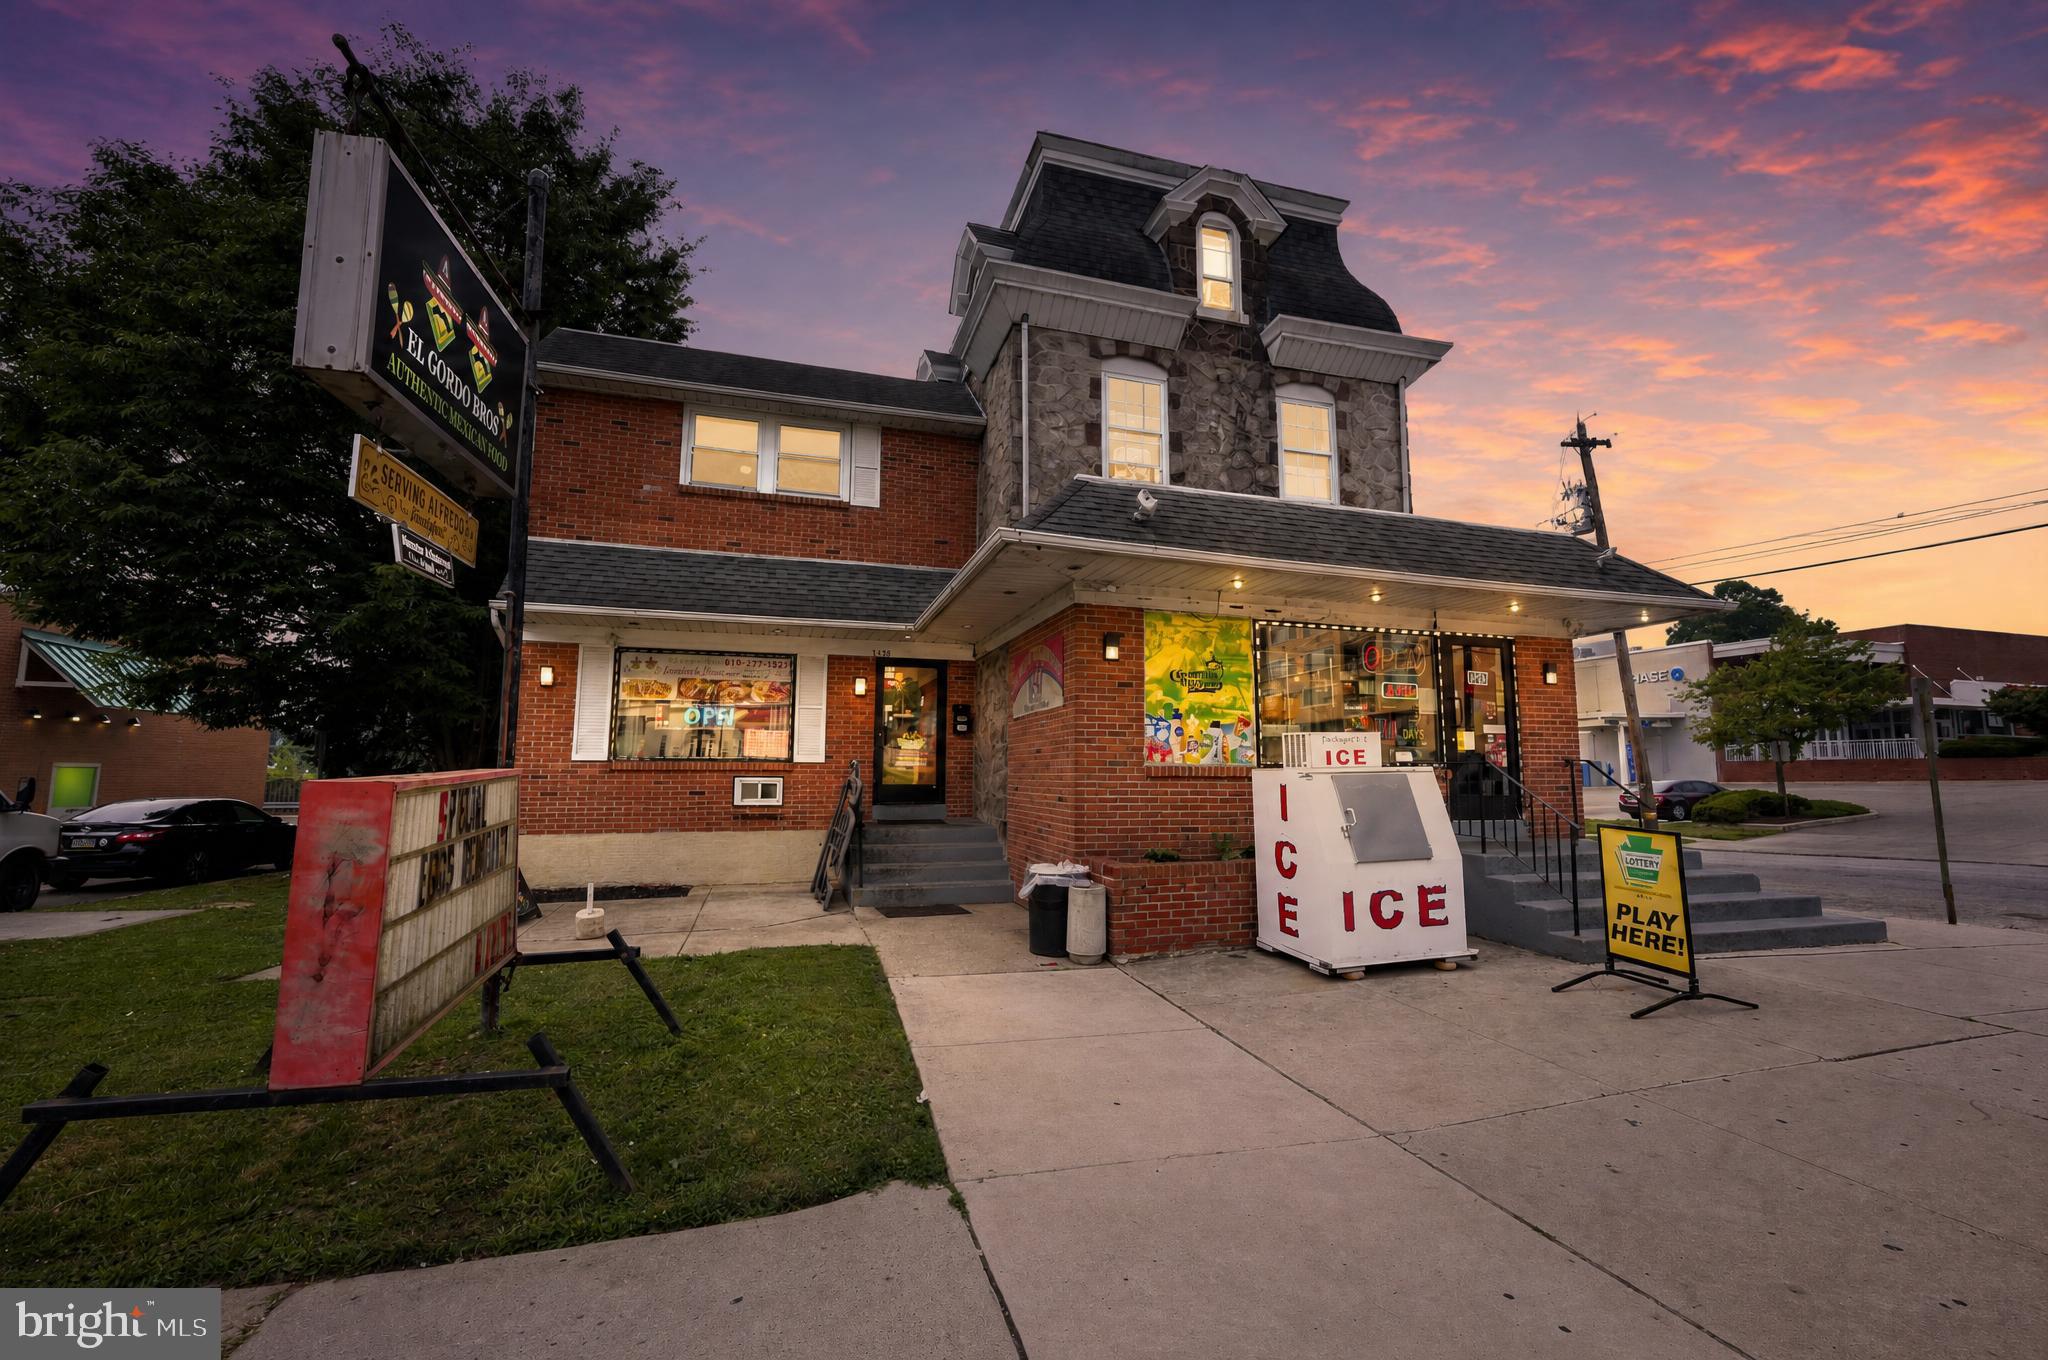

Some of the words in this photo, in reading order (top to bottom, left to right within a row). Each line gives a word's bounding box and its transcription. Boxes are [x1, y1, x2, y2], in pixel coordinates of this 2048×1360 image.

[406, 327, 425, 365] EL
[427, 350, 471, 408] GORDO
[472, 393, 500, 437] BROS
[386, 352, 449, 420] AUTHENTIC
[449, 407, 487, 453] MEXICAN
[487, 437, 508, 472] FOOD
[380, 463, 426, 509] SERVING
[428, 496, 464, 535] ALFREDO
[1402, 728, 1425, 740] DAYS
[1325, 749, 1367, 766] ICE
[1274, 783, 1300, 938] ICE
[1625, 855, 1660, 869] LOTTERY
[1342, 884, 1449, 933] ICE
[1616, 902, 1679, 932] PLAY
[1611, 923, 1684, 957] HERE!
